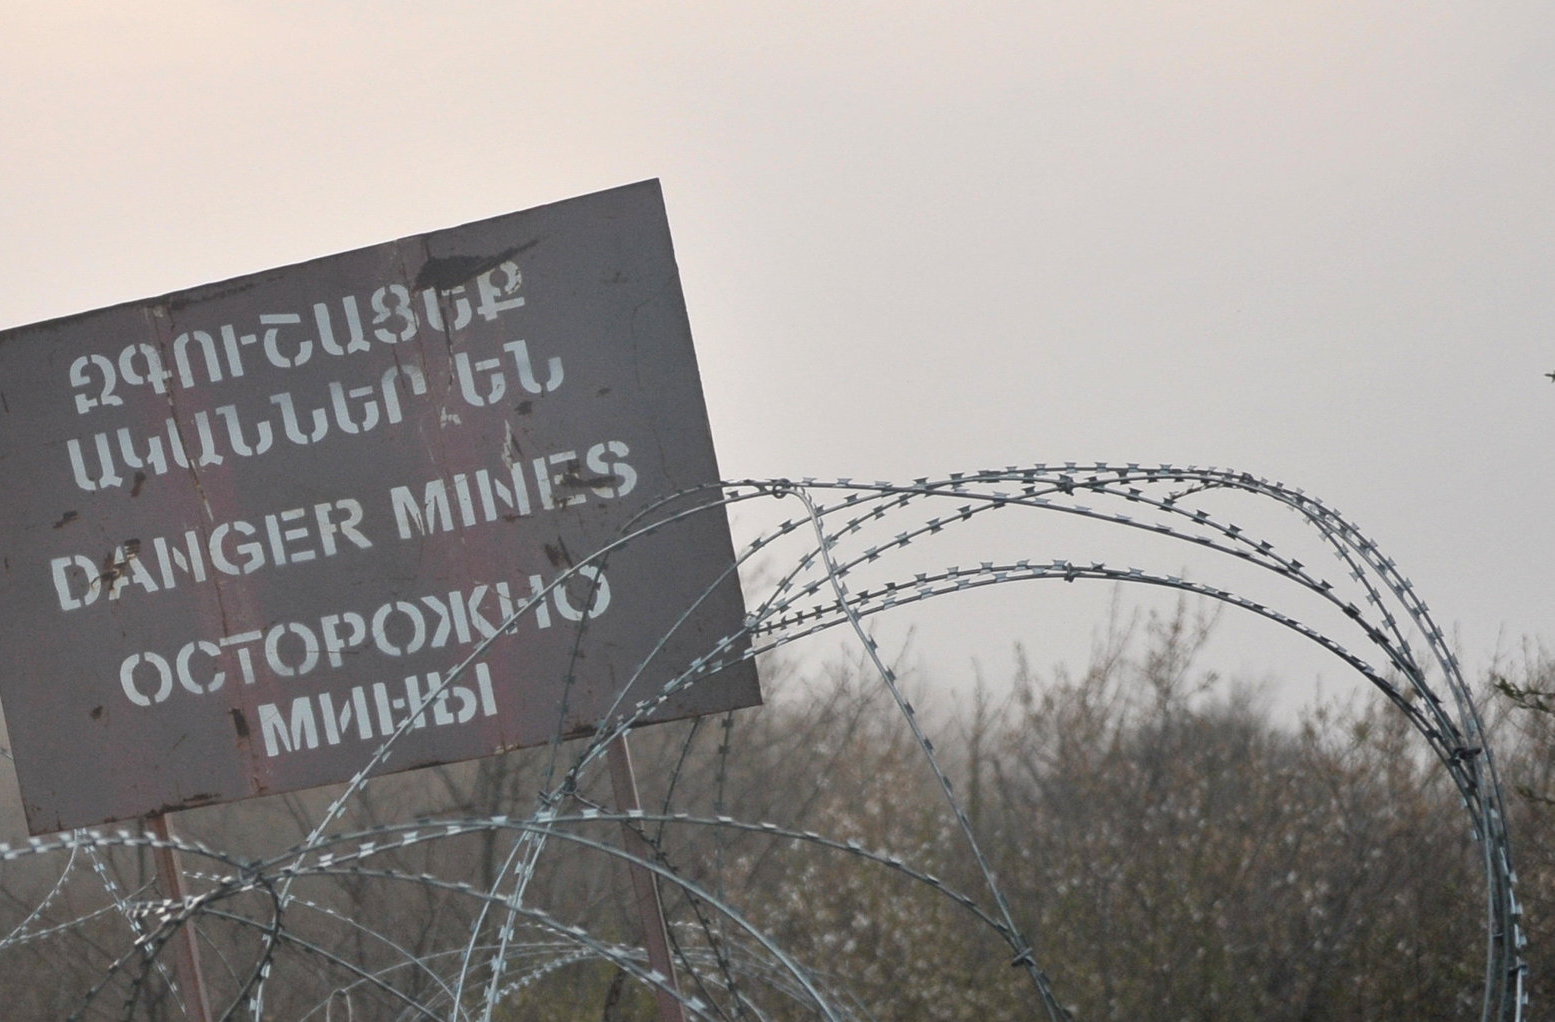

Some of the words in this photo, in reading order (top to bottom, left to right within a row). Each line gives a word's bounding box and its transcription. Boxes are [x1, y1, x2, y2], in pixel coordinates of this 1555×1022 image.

[66, 364, 428, 492] ԱԿԱՆՆԵՐ
[455, 338, 565, 409] ԵՆ
[50, 498, 374, 612] DANGER
[389, 440, 639, 540] MINES
[119, 564, 613, 707] ОСТОРОЖНО
[257, 661, 498, 758] МИНЫ
